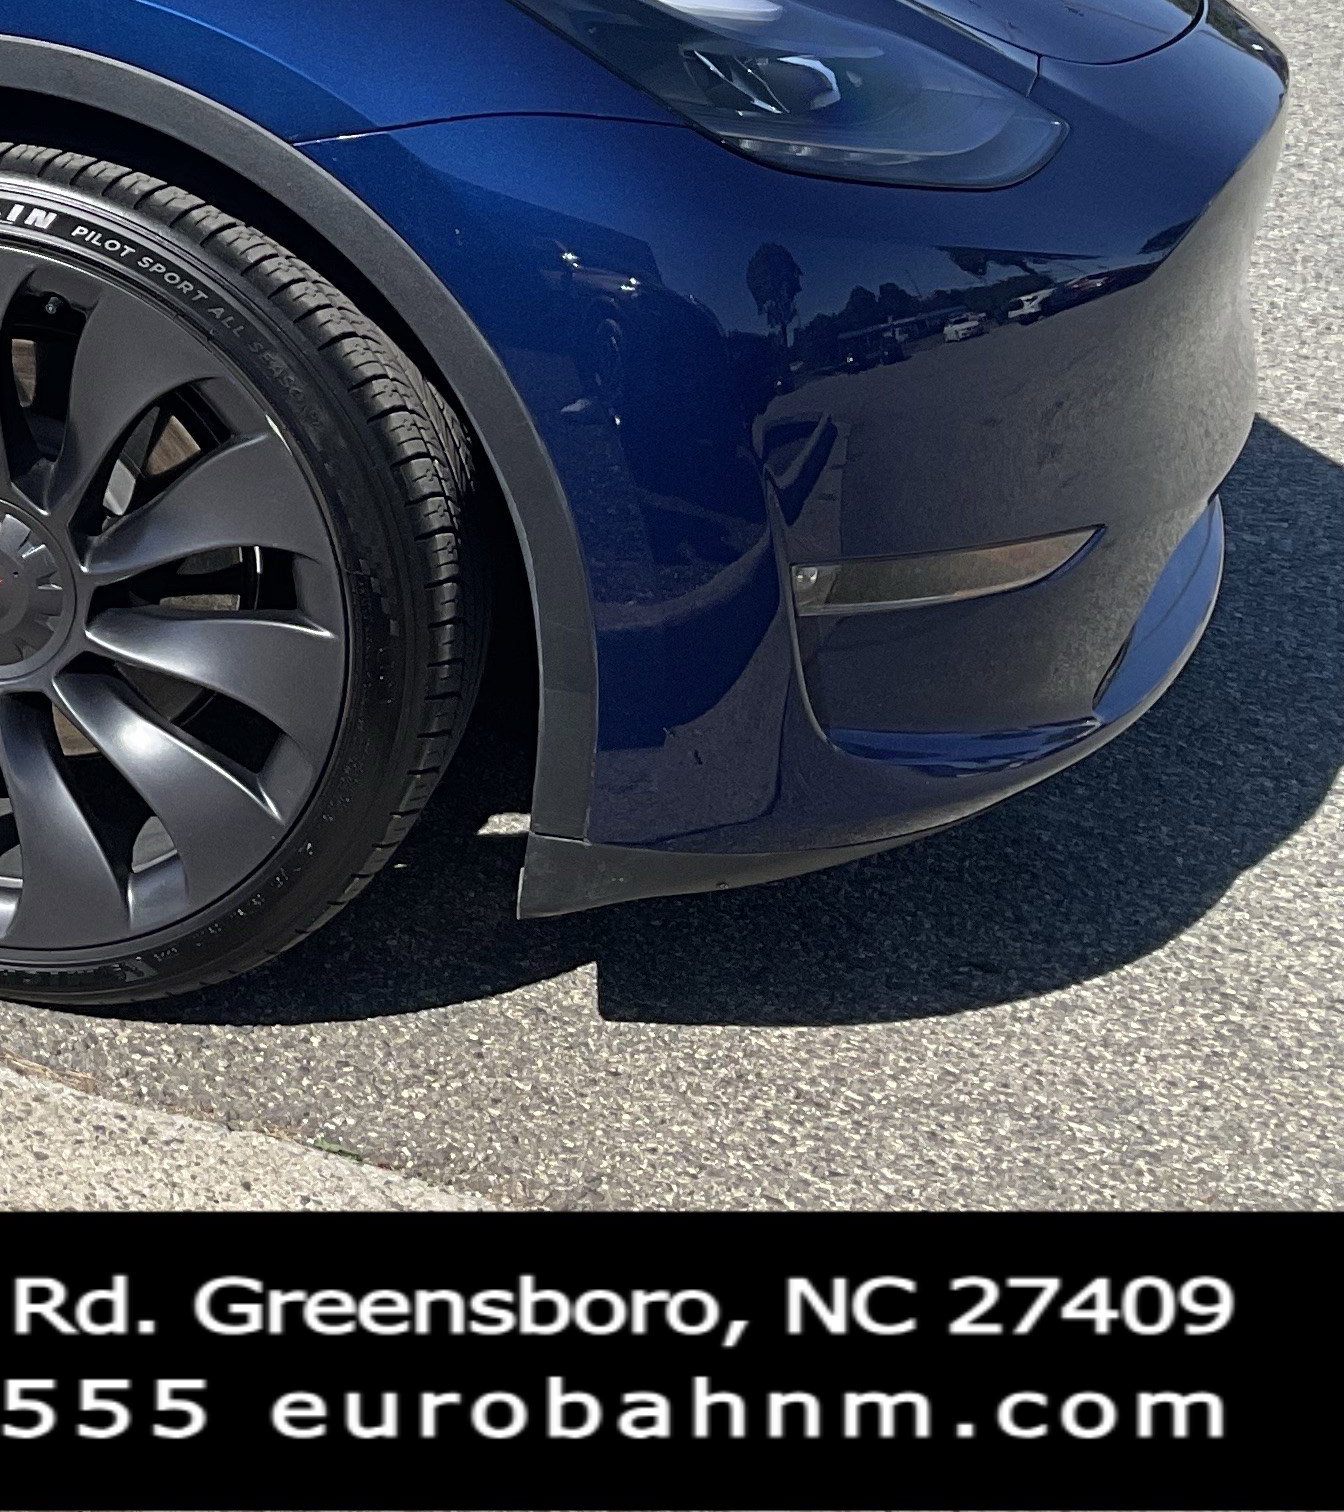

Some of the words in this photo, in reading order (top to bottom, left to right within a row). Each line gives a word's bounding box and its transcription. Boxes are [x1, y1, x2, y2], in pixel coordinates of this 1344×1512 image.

[71, 225, 136, 258] PILOT
[137, 256, 209, 302] SPORT
[207, 306, 245, 338] ALL
